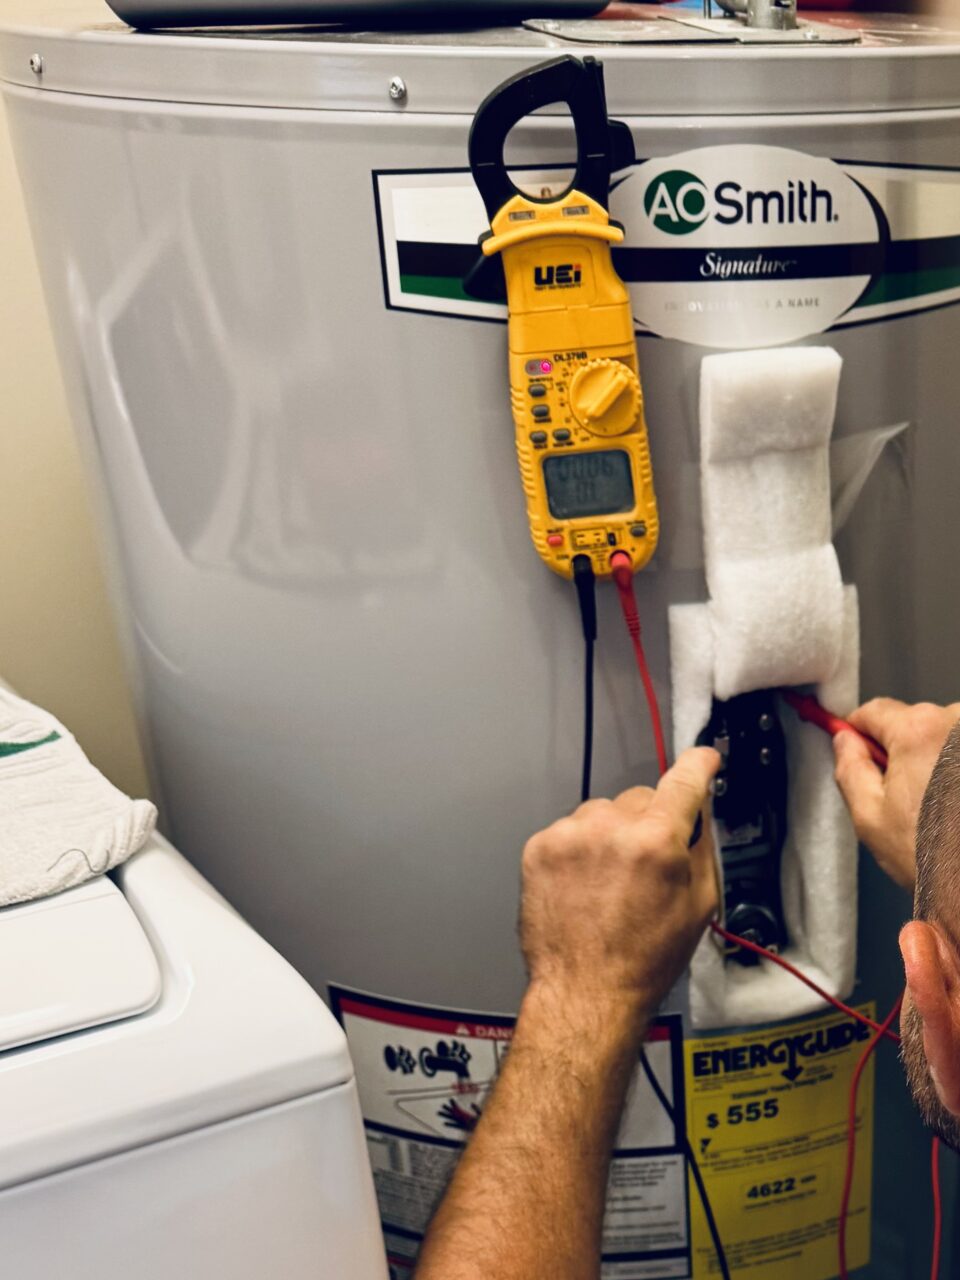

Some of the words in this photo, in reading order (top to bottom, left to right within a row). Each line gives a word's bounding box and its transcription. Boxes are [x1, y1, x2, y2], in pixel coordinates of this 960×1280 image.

[706, 1112, 720, 1129] $
[727, 1098, 779, 1125] 555
[747, 1177, 796, 1199] 4622
